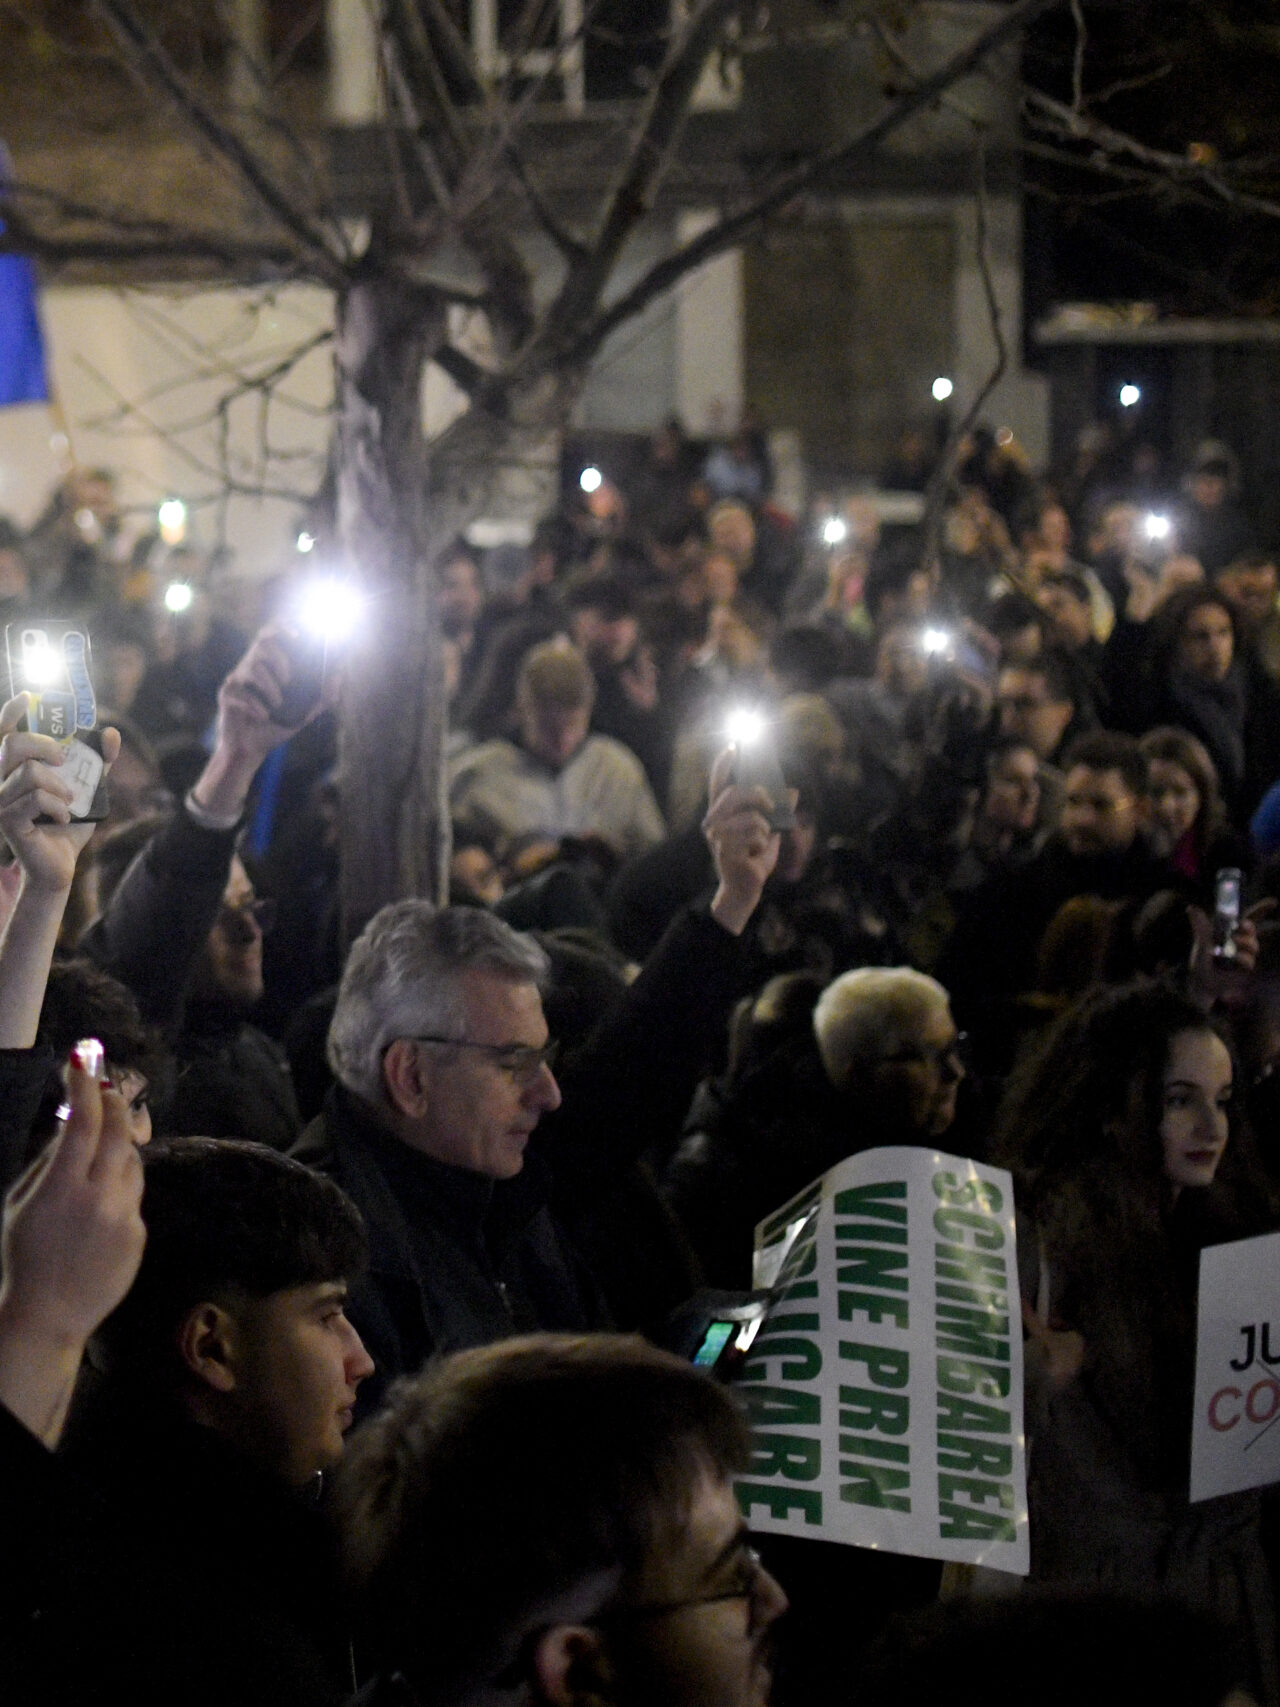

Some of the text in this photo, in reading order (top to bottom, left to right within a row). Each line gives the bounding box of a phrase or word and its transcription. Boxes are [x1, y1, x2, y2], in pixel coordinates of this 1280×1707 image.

[833, 1180, 912, 1514] VINE PRIN
[931, 1169, 1018, 1543] SCHIMBAREA
